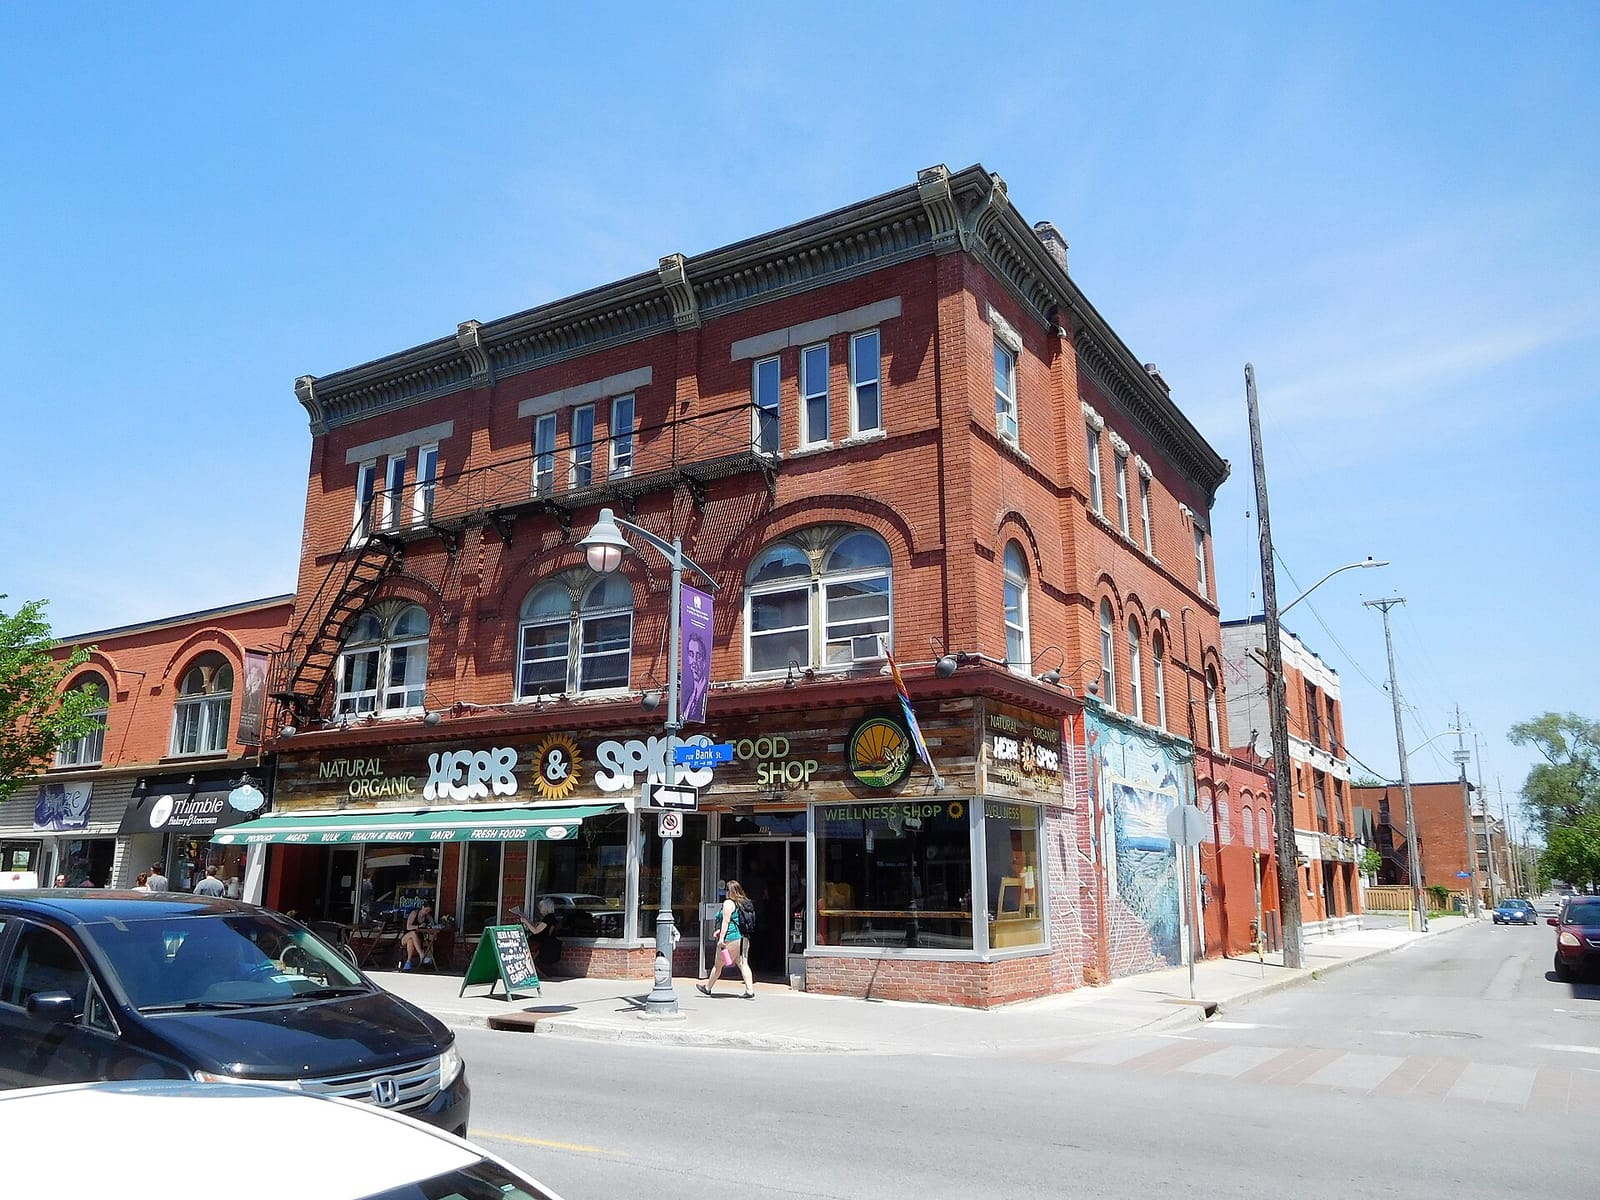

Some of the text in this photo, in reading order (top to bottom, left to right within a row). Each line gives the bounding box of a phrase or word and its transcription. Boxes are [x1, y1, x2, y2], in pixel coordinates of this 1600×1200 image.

[990, 714, 1018, 734] NATURAL
[695, 748, 713, 760] Bank
[993, 736, 1019, 760] HERB
[1036, 744, 1058, 772] SPICE
[319, 758, 384, 778] NATURAL
[422, 746, 519, 801] HERB
[546, 749, 568, 780] &
[757, 759, 819, 785] SHOP
[349, 776, 416, 796] ORGANIC
[174, 797, 224, 814] Thimble
[825, 804, 942, 821] WELLNESS SHOP
[284, 833, 310, 842] MEATS
[321, 832, 340, 842] BULK
[351, 831, 378, 841] HEALTH
[384, 831, 415, 841] BEAUTY
[430, 830, 456, 840] DAIRY
[470, 829, 497, 839] FRESH
[498, 828, 527, 838] FOODS
